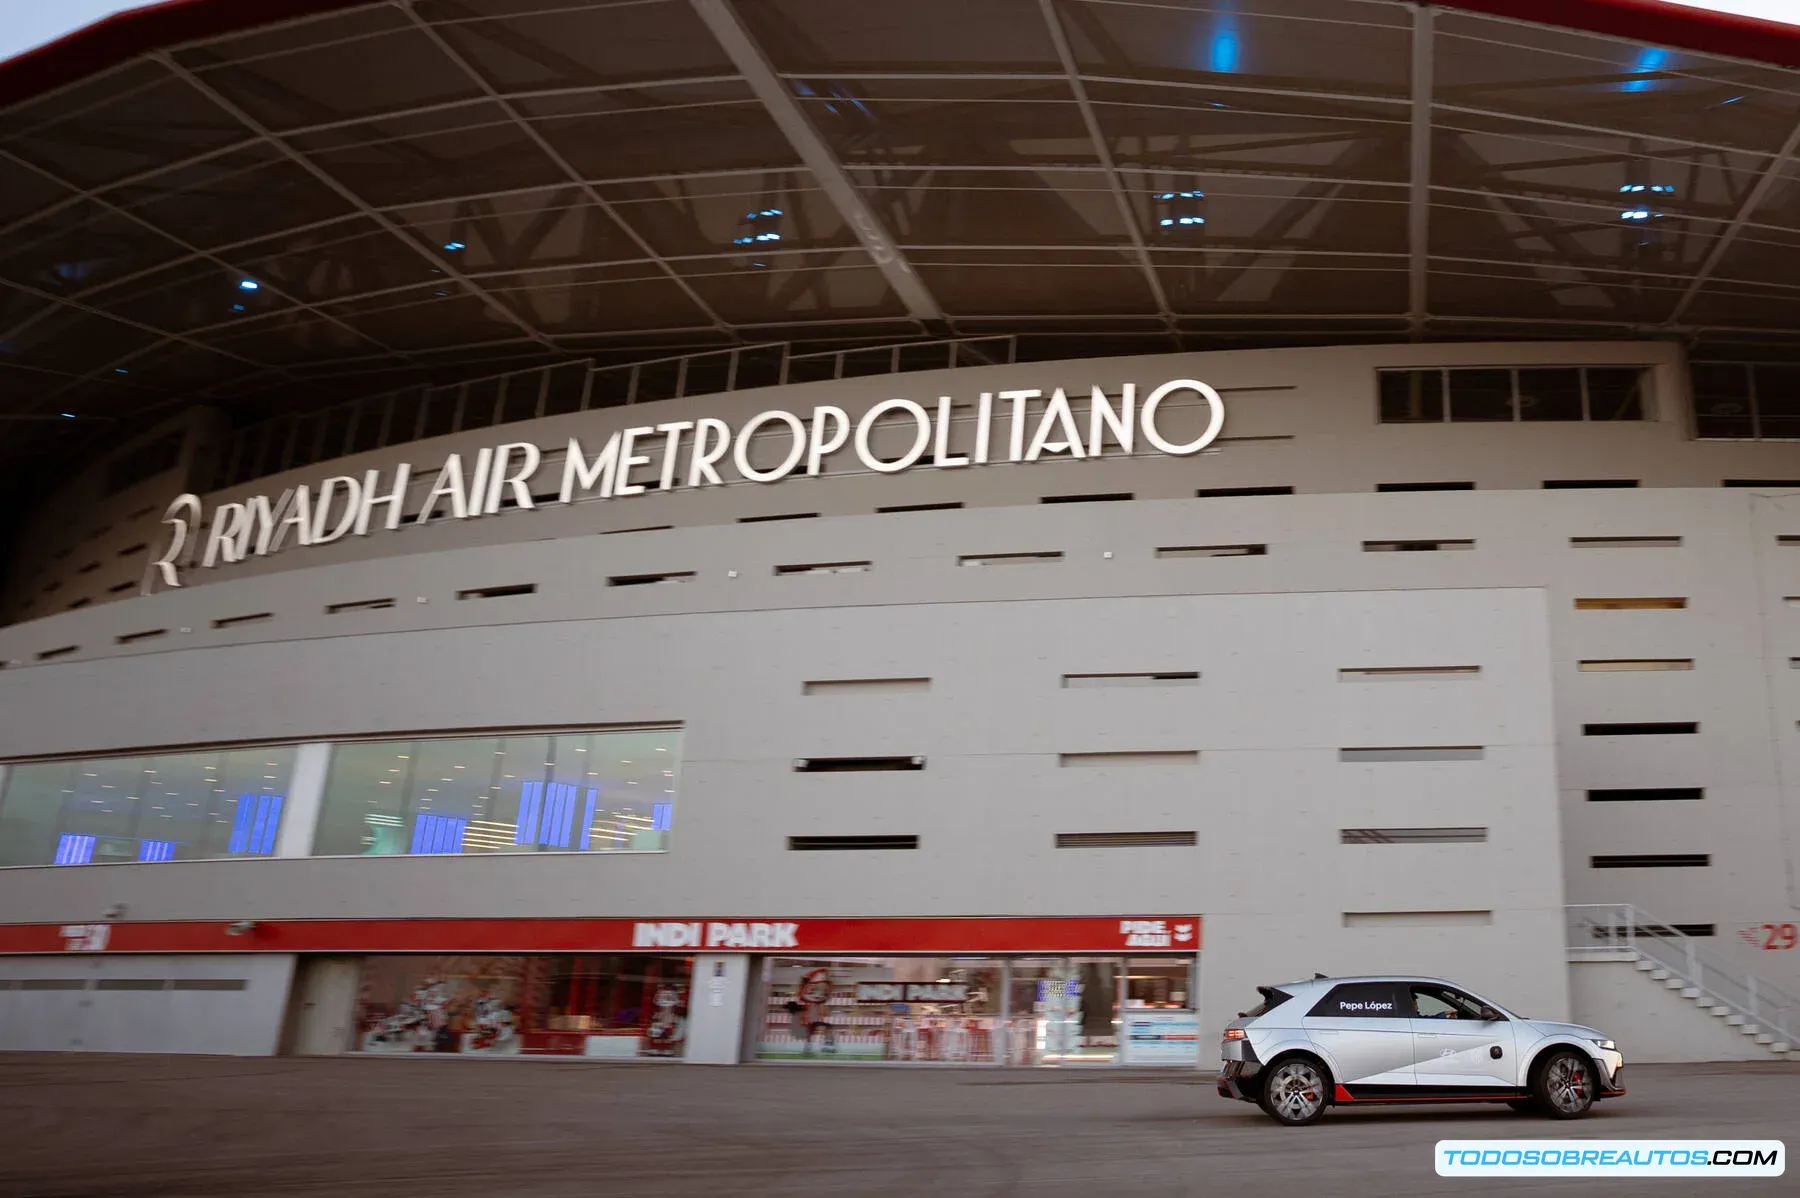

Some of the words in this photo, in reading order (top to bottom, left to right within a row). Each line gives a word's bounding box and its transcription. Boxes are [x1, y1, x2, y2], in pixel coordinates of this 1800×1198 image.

[201, 462, 413, 568] RIYADH
[417, 440, 542, 525] AIR
[559, 378, 1226, 505] METROPOLITANO
[632, 922, 703, 947] INDI
[706, 922, 800, 948] PARK
[1760, 923, 1798, 951] 29
[1339, 1001, 1363, 1011] Pepe
[1364, 1000, 1393, 1011] López
